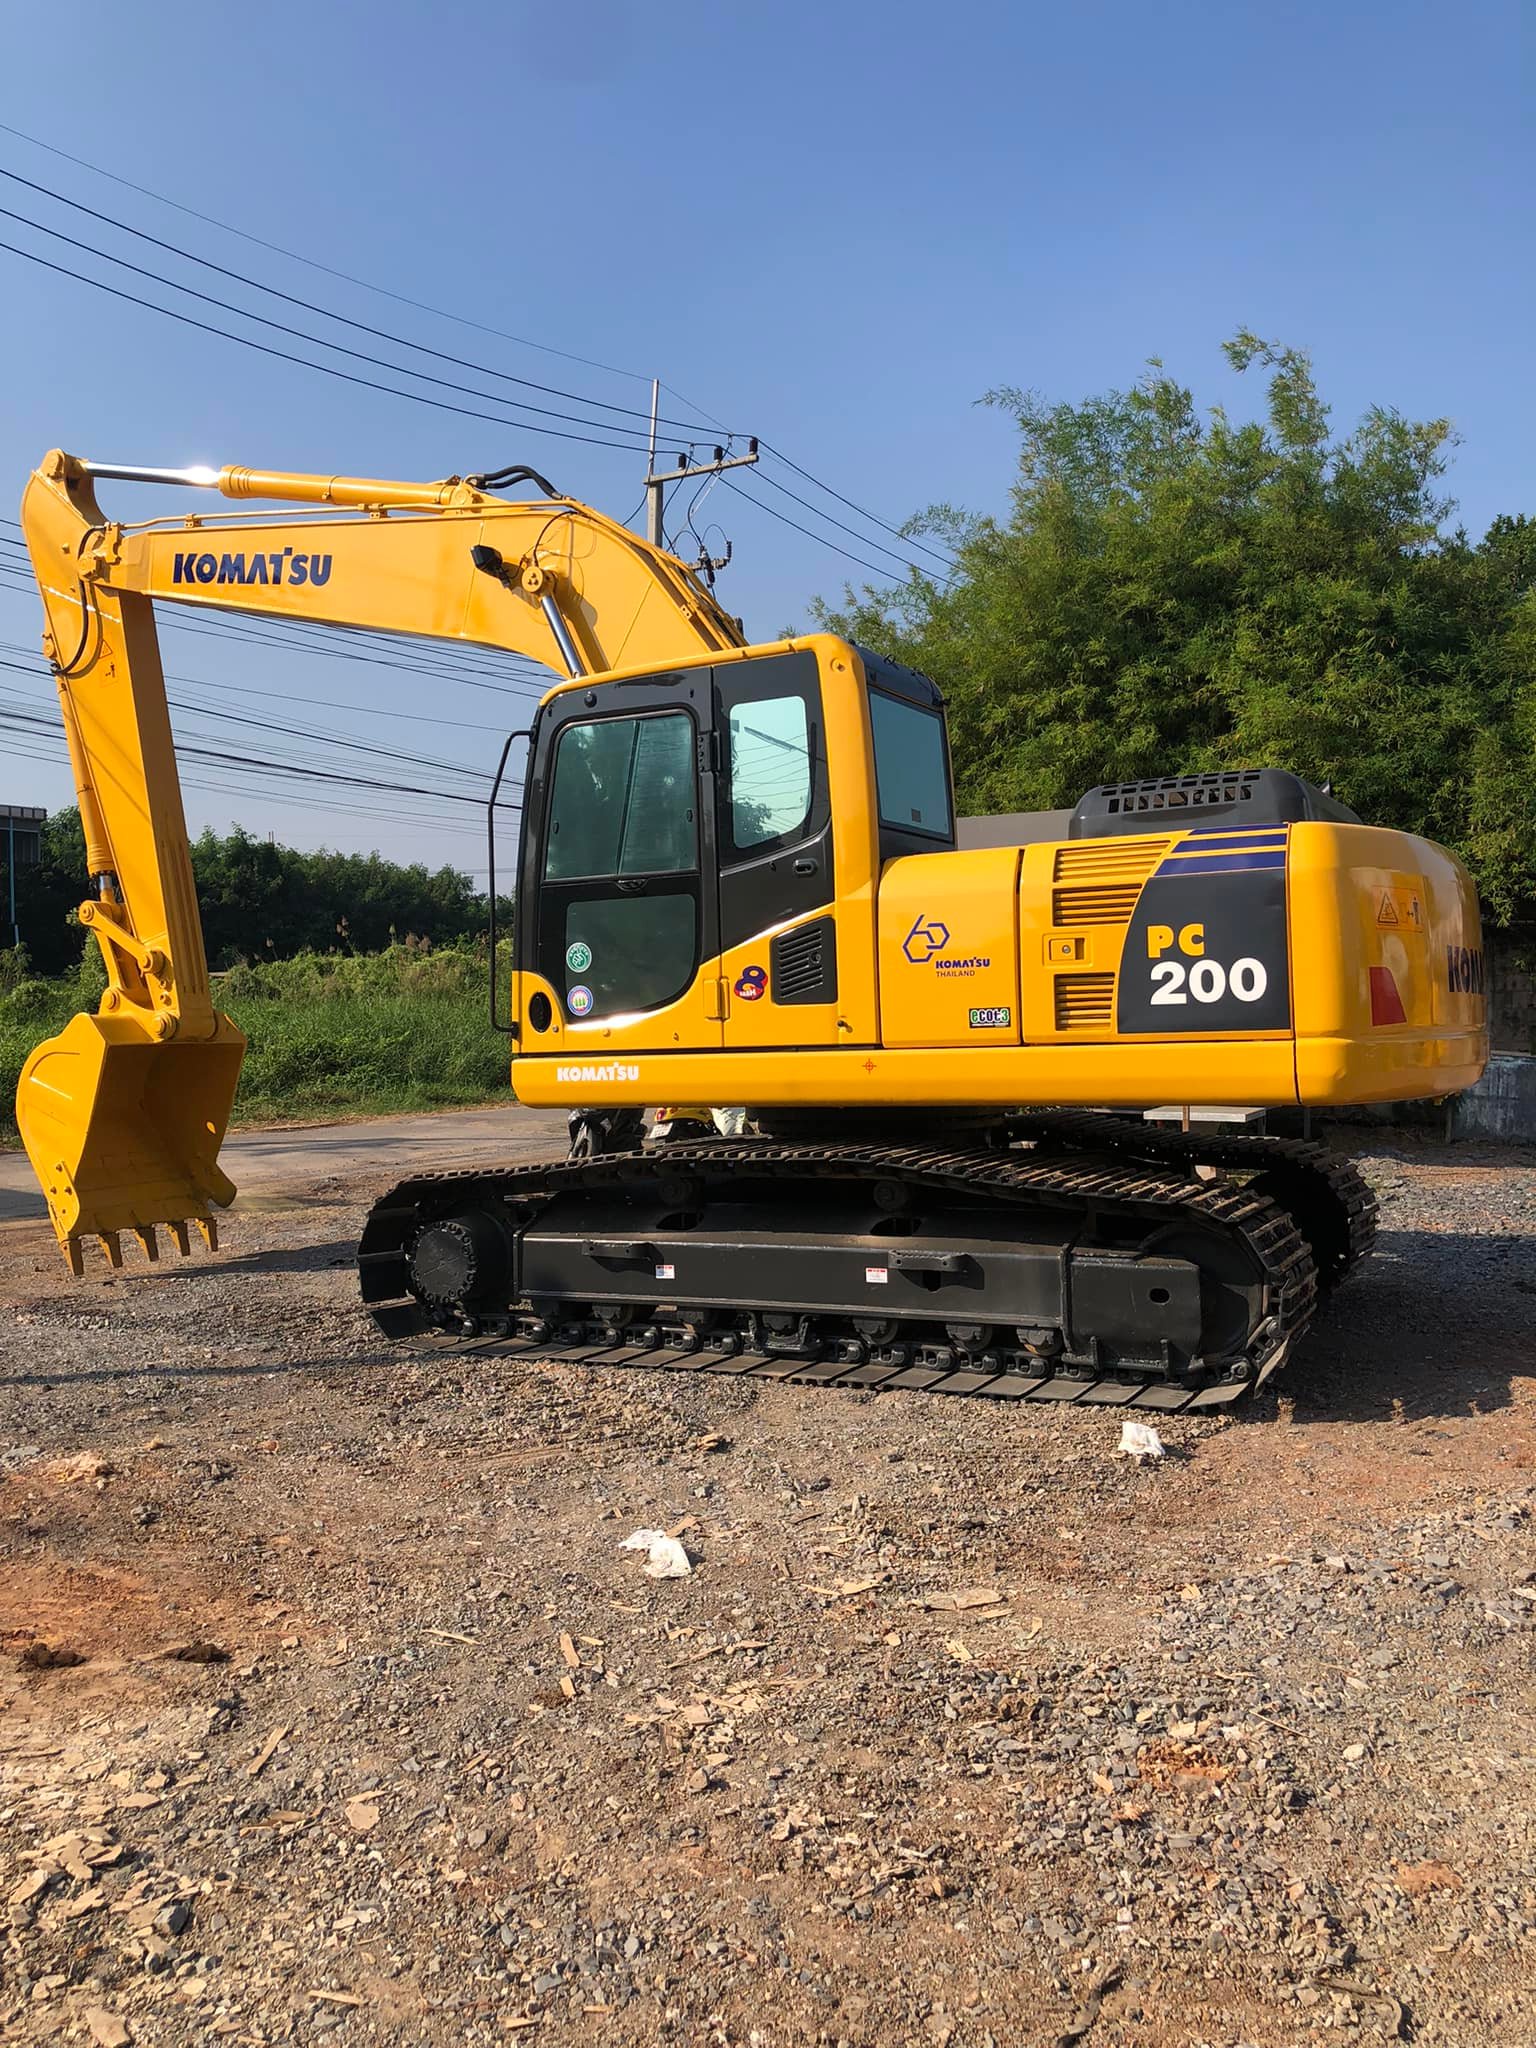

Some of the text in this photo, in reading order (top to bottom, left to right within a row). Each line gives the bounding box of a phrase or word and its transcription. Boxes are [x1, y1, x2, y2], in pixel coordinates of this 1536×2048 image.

[173, 547, 333, 586] KOMATSU
[1147, 923, 1205, 958] PC
[936, 956, 990, 969] KOMATSU
[1150, 957, 1267, 1005] 200
[971, 1009, 1009, 1022] ecot3
[557, 1062, 639, 1082] KOMATSU
